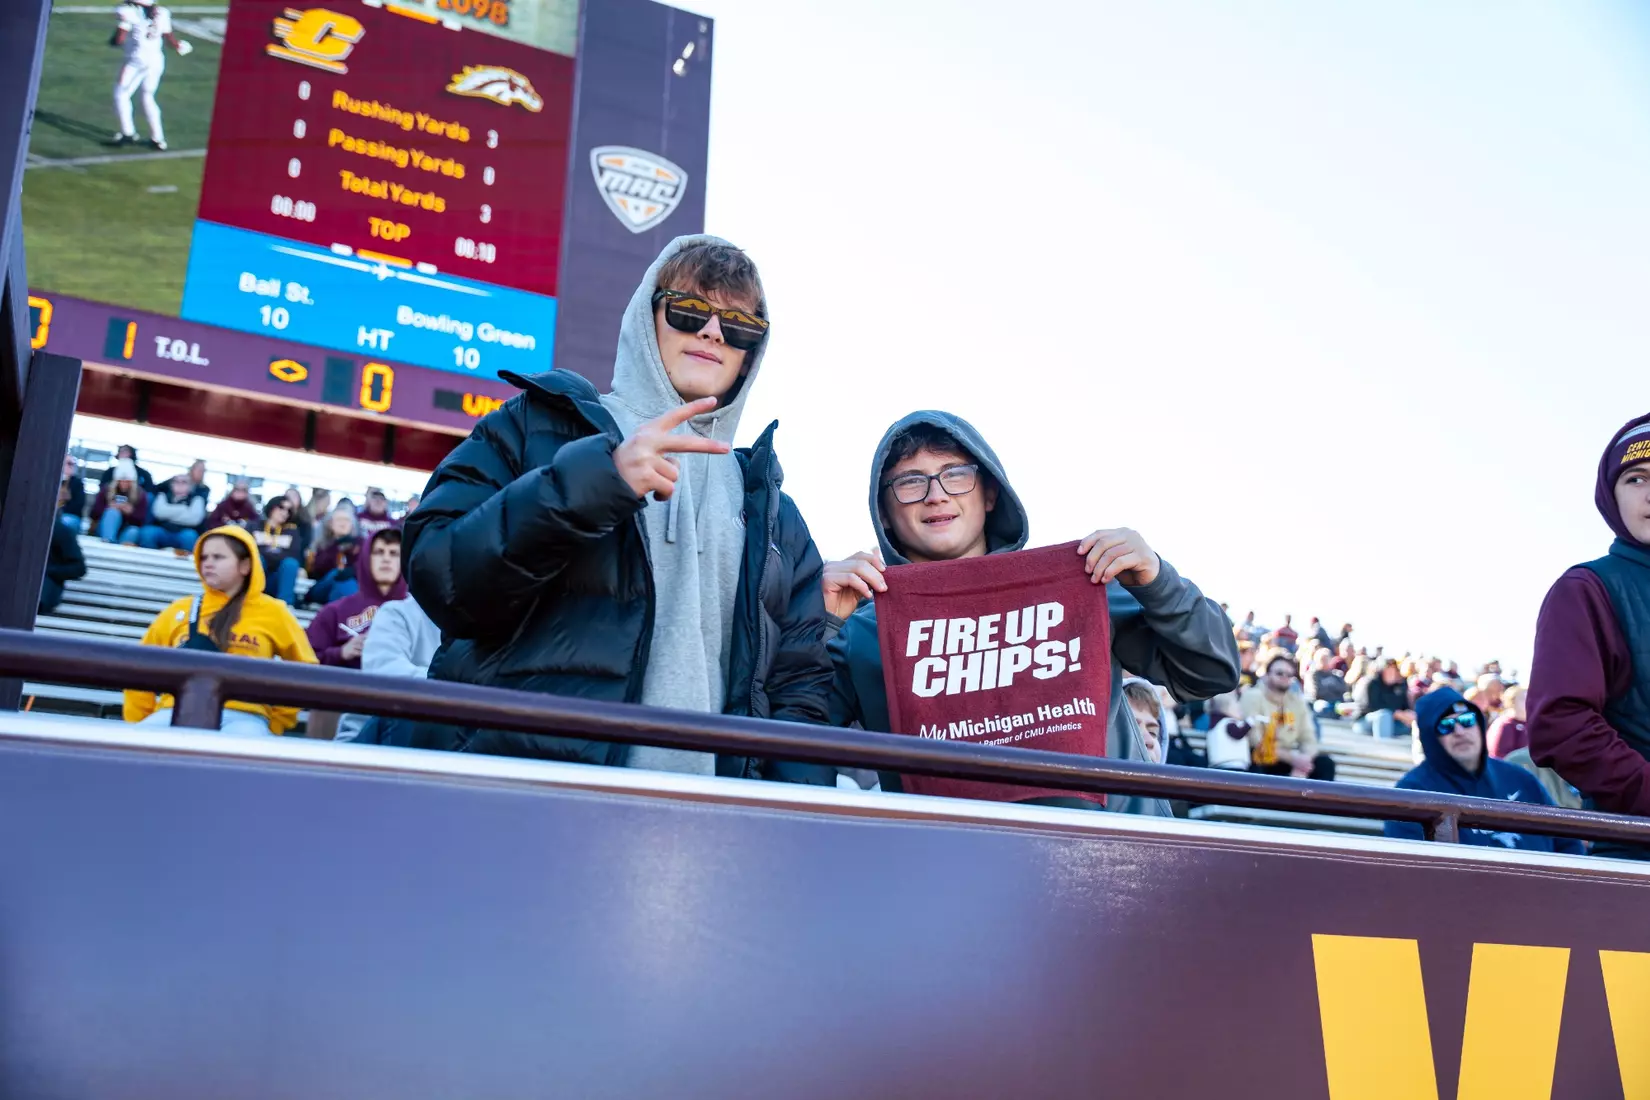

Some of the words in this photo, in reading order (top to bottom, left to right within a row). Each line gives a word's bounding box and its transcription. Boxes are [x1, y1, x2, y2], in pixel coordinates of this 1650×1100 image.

[298, 80, 311, 101] 0
[293, 118, 307, 139] 0
[331, 89, 414, 132] Rushing
[414, 111, 471, 143] Yards
[288, 157, 302, 178] 0
[328, 128, 409, 169] Passing
[409, 148, 466, 180] Yards
[339, 169, 389, 200] Total
[389, 181, 446, 213] Yards
[367, 216, 412, 243] TOP
[238, 271, 282, 299] Ball
[284, 281, 315, 306] St.
[259, 304, 290, 330] 10
[396, 304, 474, 342] Bowling
[475, 321, 537, 351] Green
[153, 335, 210, 367] T.O.L.
[357, 325, 395, 351] HT
[452, 345, 481, 370] 10
[360, 362, 394, 413] 0
[905, 613, 1002, 657] FIRE
[1004, 601, 1065, 645] UP
[911, 636, 1082, 698] CHIPS!
[919, 723, 948, 741] My
[948, 711, 1034, 740] Michigan
[1037, 697, 1096, 722] Health
[1014, 733, 1024, 742] of
[1024, 727, 1045, 740] CMU
[1046, 721, 1083, 735] Athletics
